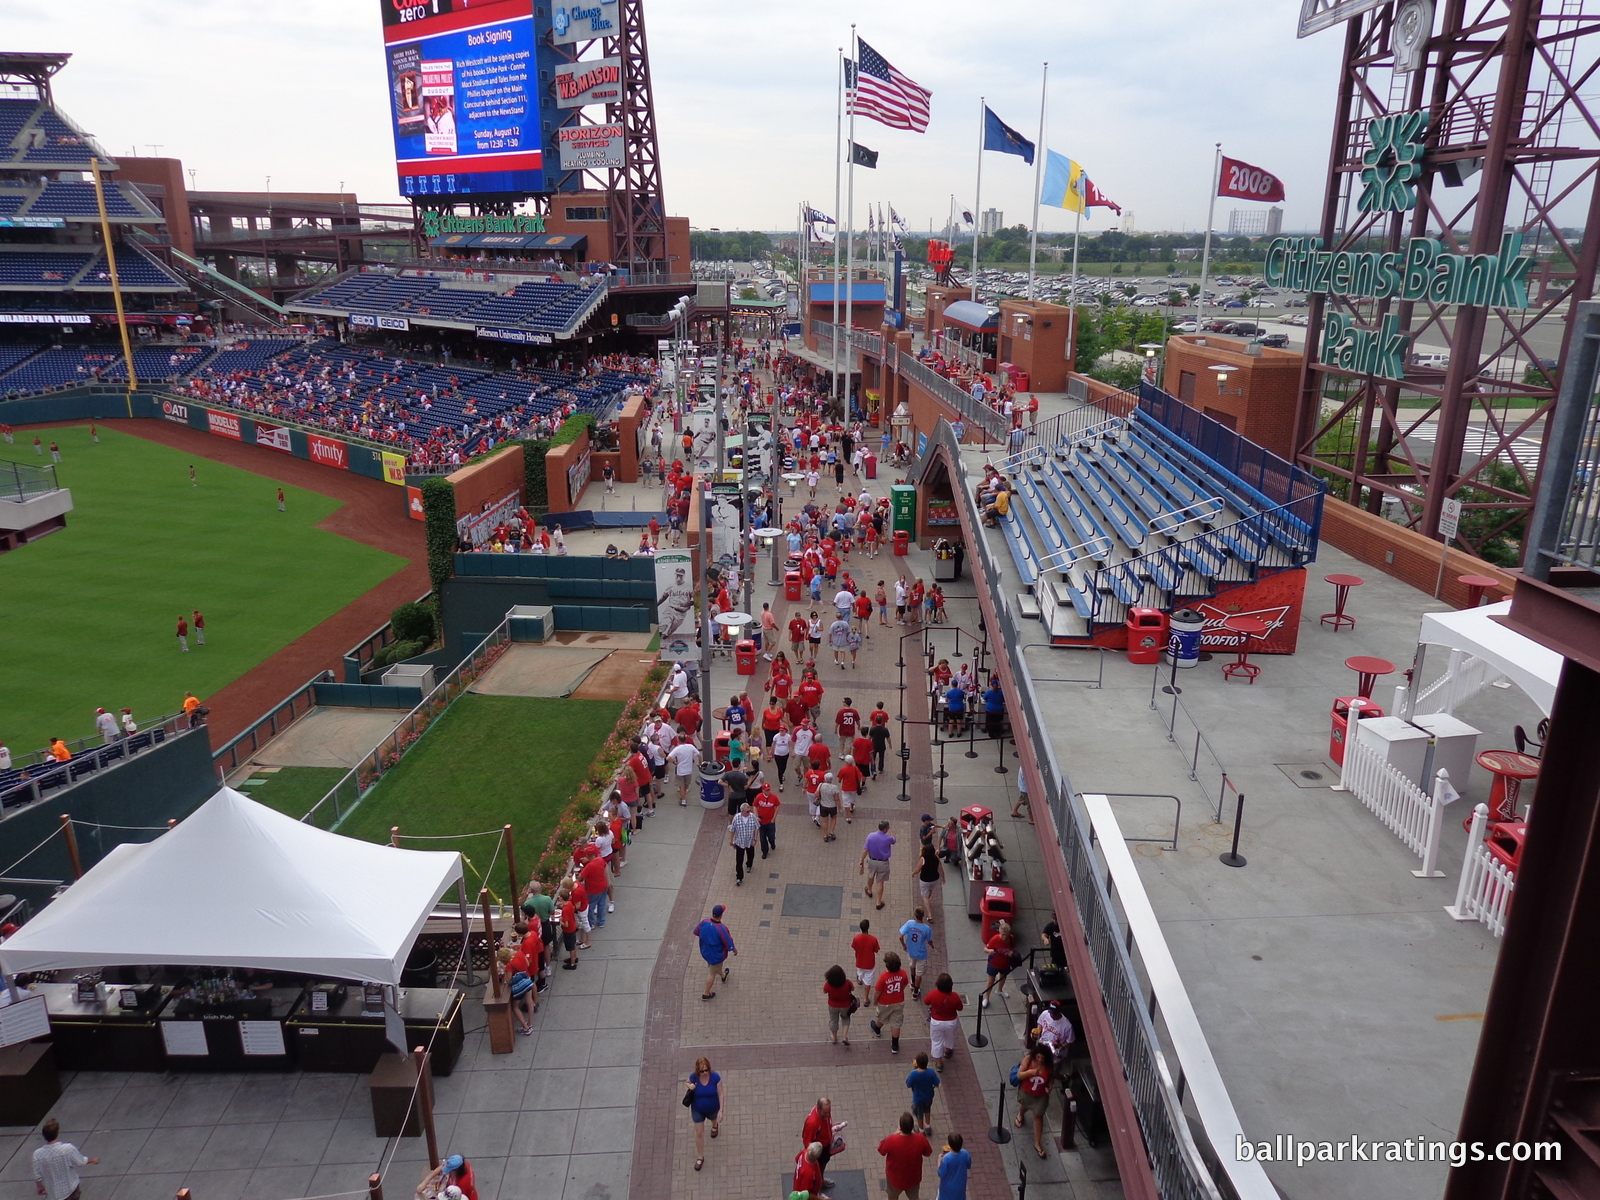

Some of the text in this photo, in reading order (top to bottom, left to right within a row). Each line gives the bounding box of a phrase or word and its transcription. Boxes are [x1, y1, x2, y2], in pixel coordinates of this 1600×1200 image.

[400, 5, 425, 23] zero
[571, 6, 601, 20] Choose
[591, 16, 613, 31] Blue.
[468, 29, 512, 46] Book Signing
[456, 60, 465, 68] Rich
[465, 58, 483, 66] Westcott
[498, 52, 514, 62] signing
[515, 50, 530, 60] copies
[462, 70, 466, 78] of
[473, 68, 485, 76] books
[487, 66, 498, 74] Shibe
[511, 62, 526, 71] Connie
[473, 79, 489, 87] Stadium
[498, 75, 508, 83] Tales
[509, 74, 519, 82] from
[467, 90, 480, 98] Phillies
[481, 89, 496, 97] Dugout
[486, 98, 500, 107] behind
[469, 110, 486, 120] adjacent
[500, 106, 524, 115] NewsStand
[474, 127, 520, 139] Sunday, August 12
[560, 126, 622, 142] HORIZON
[477, 141, 489, 149] from
[490, 140, 503, 148] 12:30
[508, 139, 519, 147] 1:30
[572, 140, 609, 149] SERVICES
[577, 151, 605, 159] PLUMBING
[564, 158, 620, 168] HEATING COOLING
[1228, 165, 1274, 194] 2008
[441, 212, 546, 233] Citizens Bank Park
[1264, 232, 1536, 309] Citizens Bank
[54, 315, 92, 323] PHILLIES
[352, 315, 375, 325] GEICO
[381, 318, 405, 328] GEICO
[476, 327, 552, 345] Jefferson University Hospitals
[1320, 312, 1410, 380] Park
[171, 404, 188, 418] ATI
[208, 414, 239, 430] MODELL'S
[210, 425, 240, 437] SPORTING GOODS
[312, 440, 343, 465] xfinity
[372, 451, 381, 461] 374
[843, 717, 854, 725] 20
[912, 933, 918, 943] 8
[887, 982, 900, 994] 34
[1030, 1076, 1044, 1091] P
